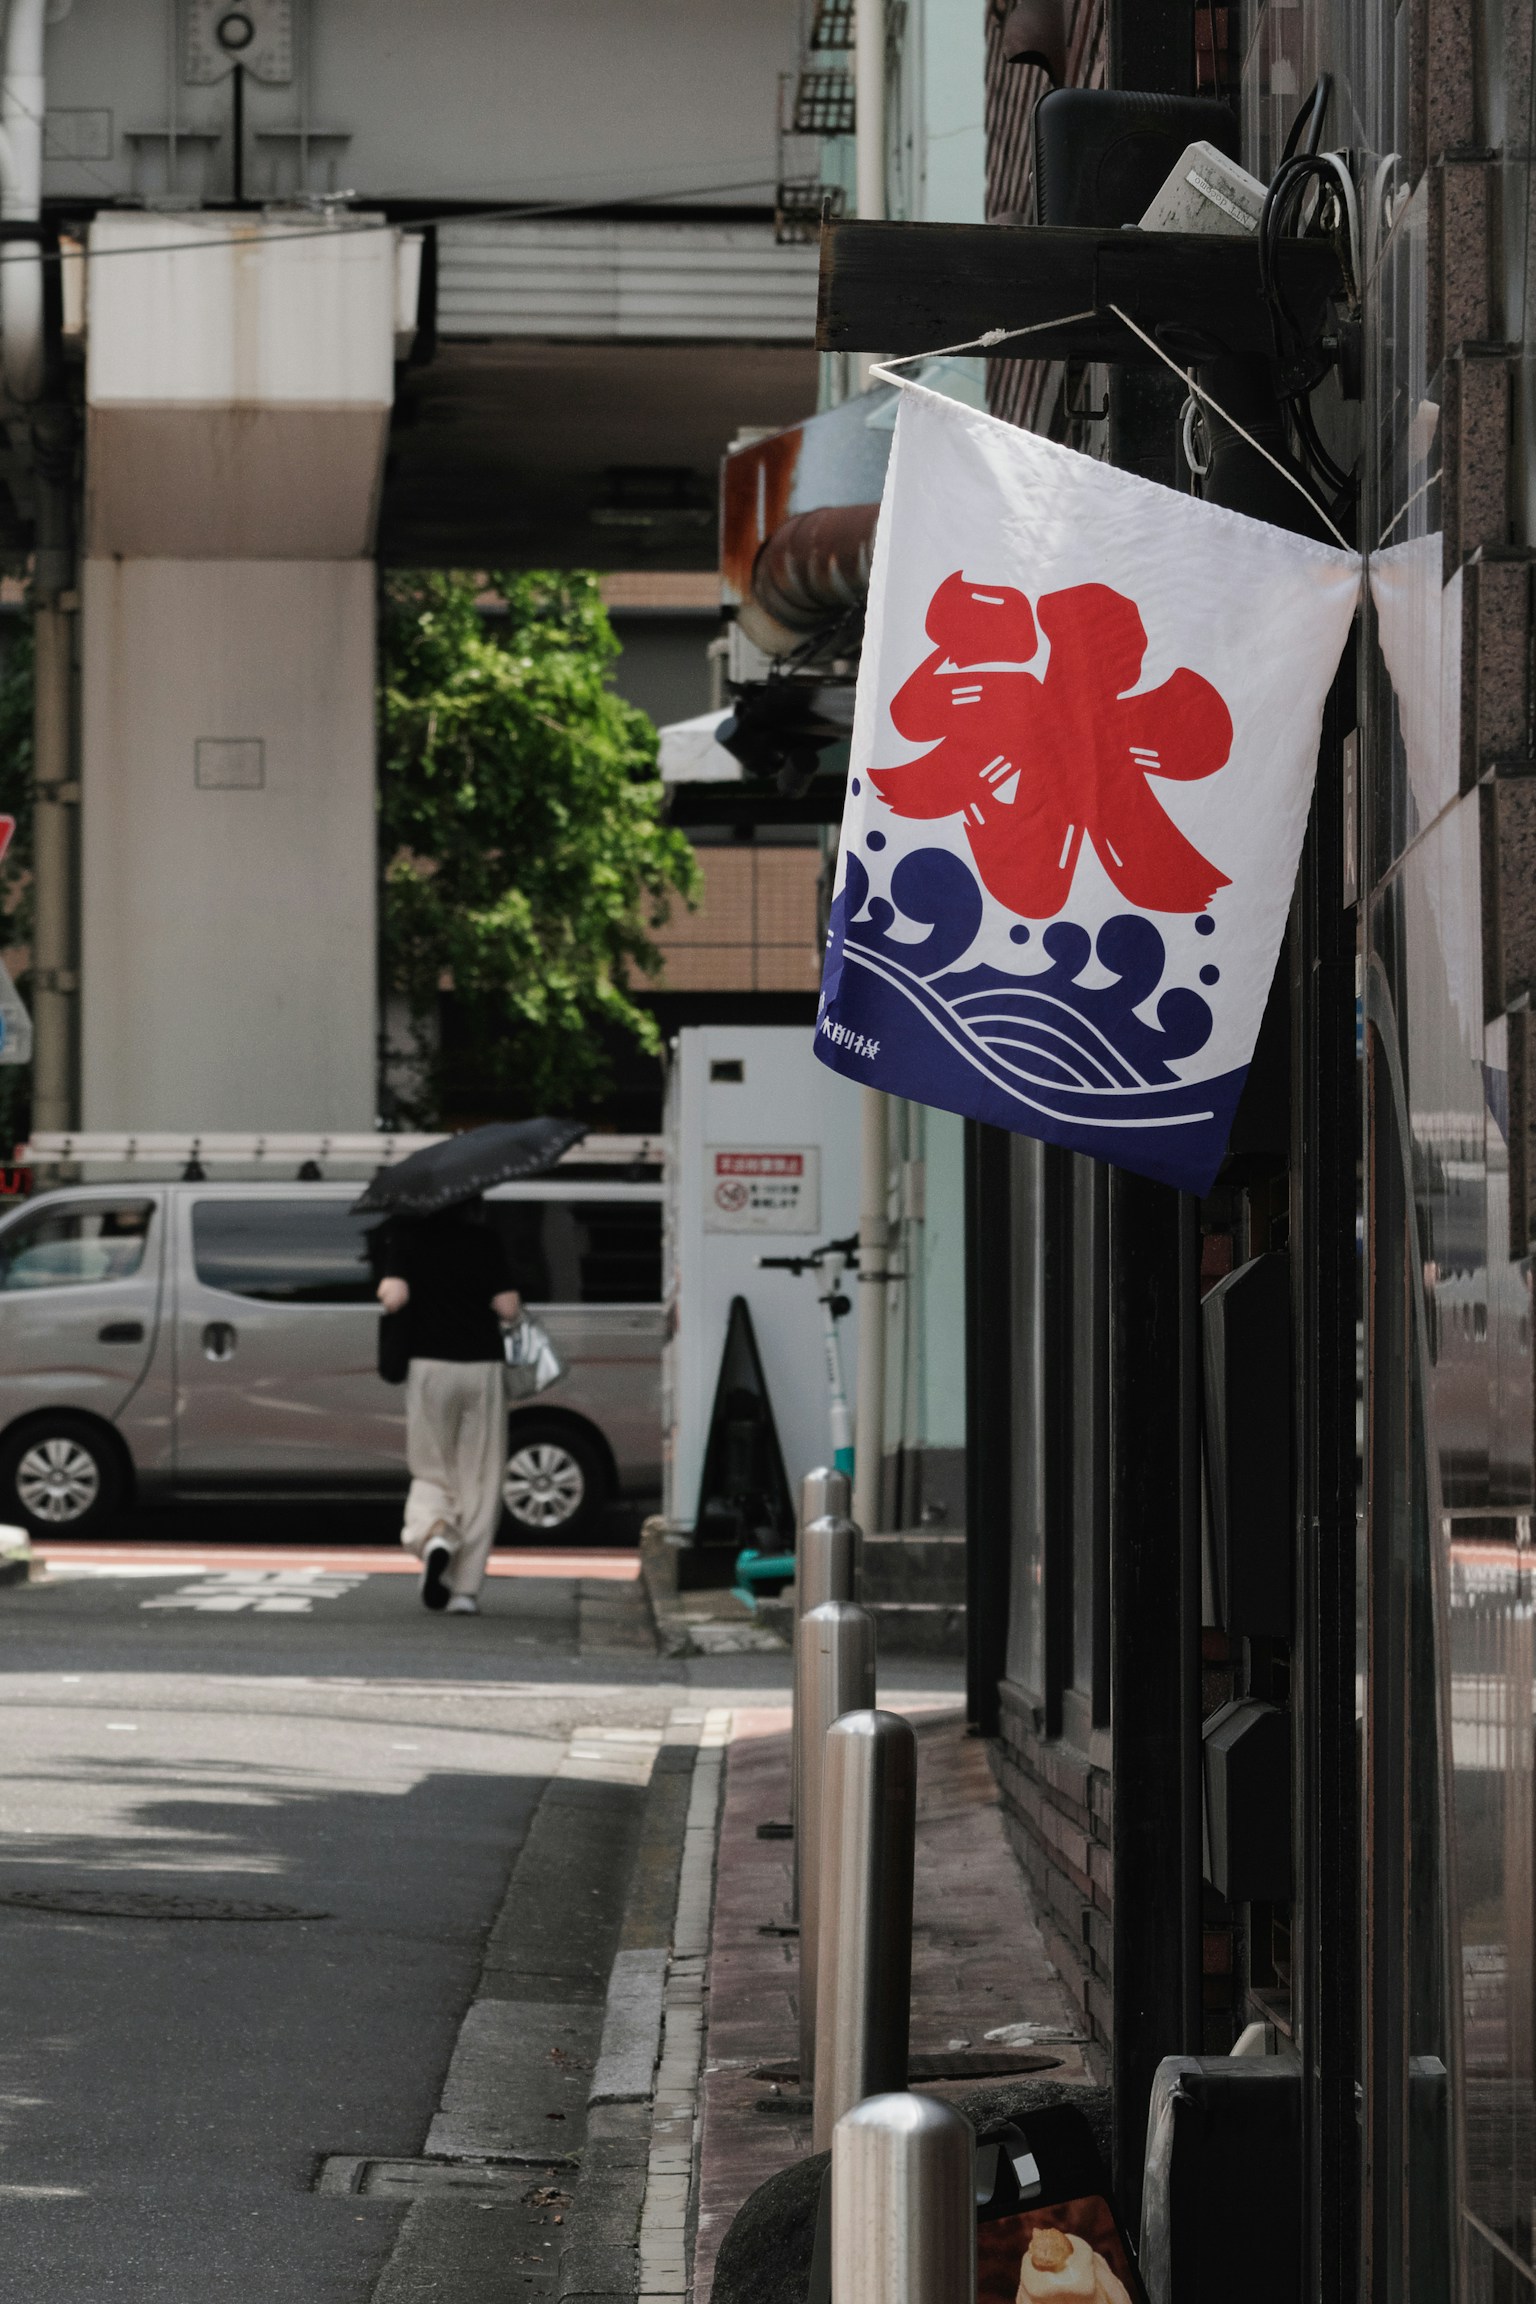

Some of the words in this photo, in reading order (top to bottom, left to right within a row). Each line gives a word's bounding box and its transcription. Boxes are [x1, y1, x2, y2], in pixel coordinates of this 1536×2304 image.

[1195, 177, 1227, 206] docomo
[1229, 207, 1249, 224] NTT
[866, 570, 1234, 920] 氷
